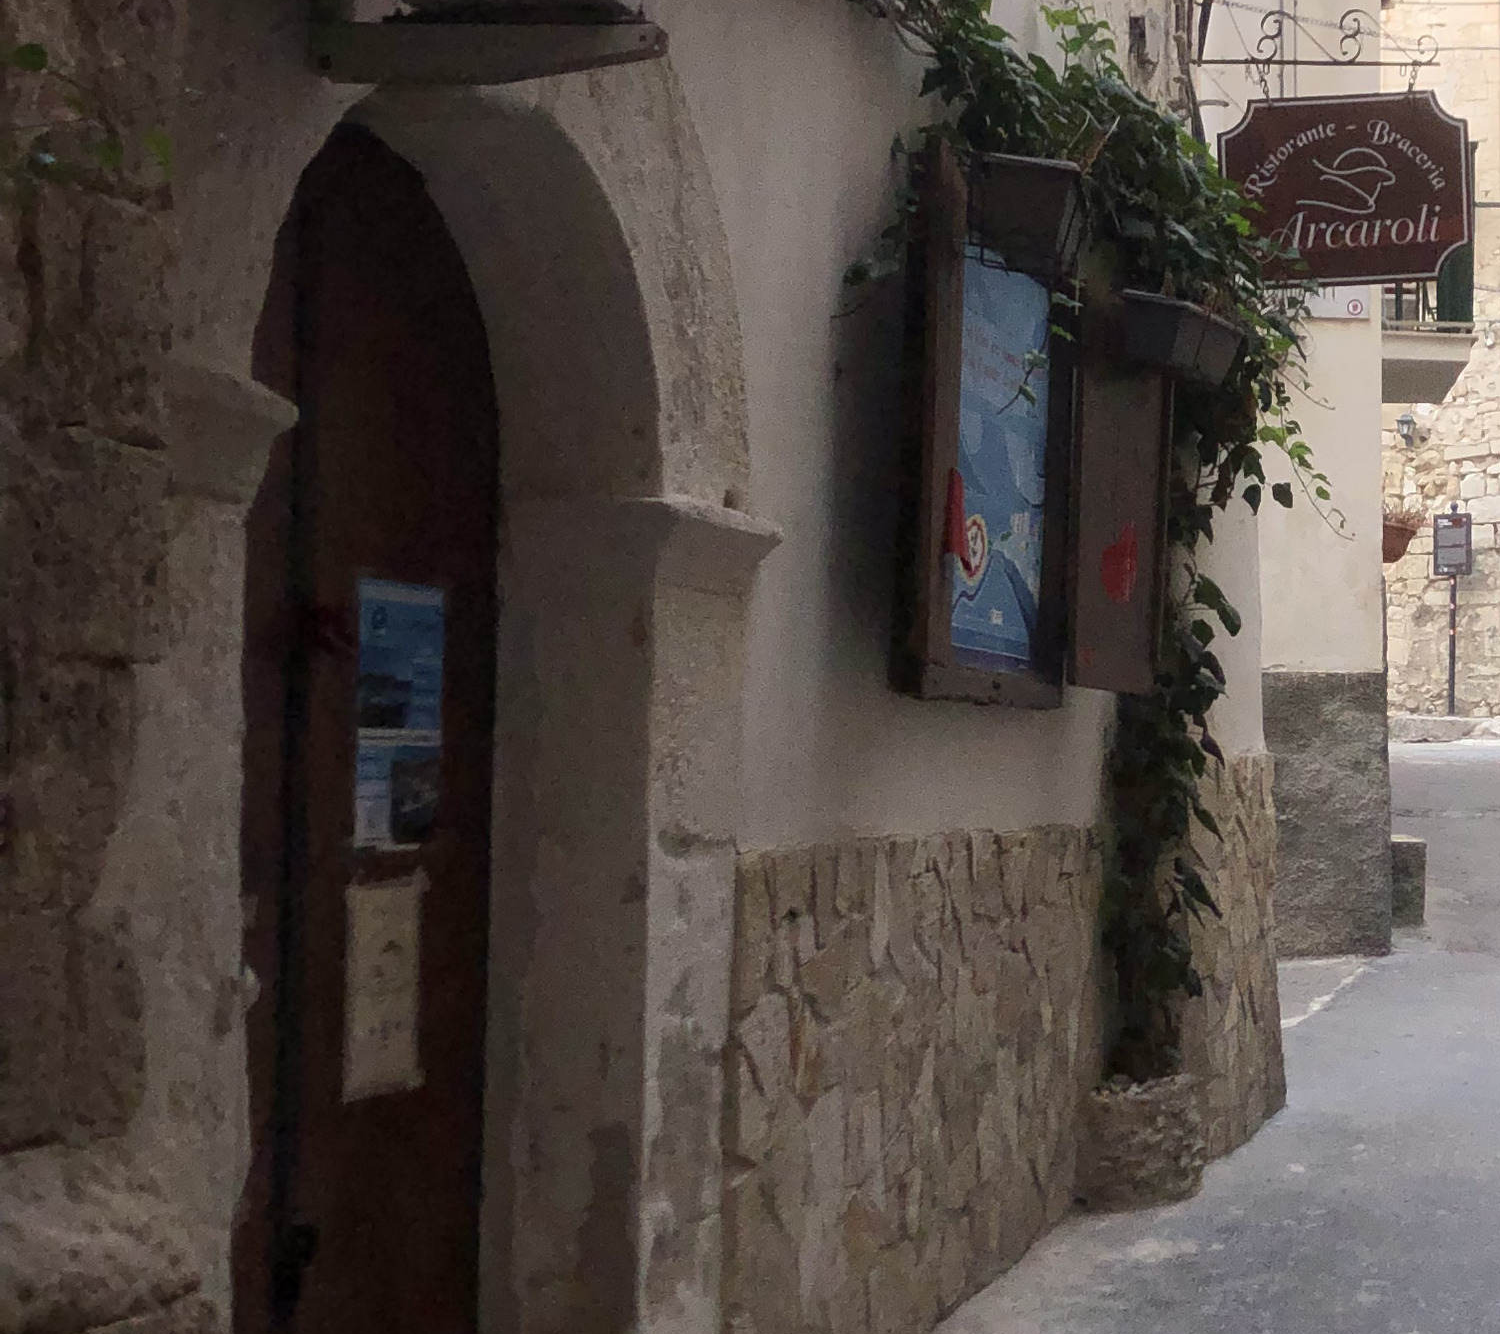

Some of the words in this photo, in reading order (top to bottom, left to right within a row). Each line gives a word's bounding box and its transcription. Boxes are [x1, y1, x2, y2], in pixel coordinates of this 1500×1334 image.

[1243, 120, 1337, 199] Ristorante
[1366, 119, 1447, 191] Braceria
[1254, 204, 1442, 261] Arcaroli
